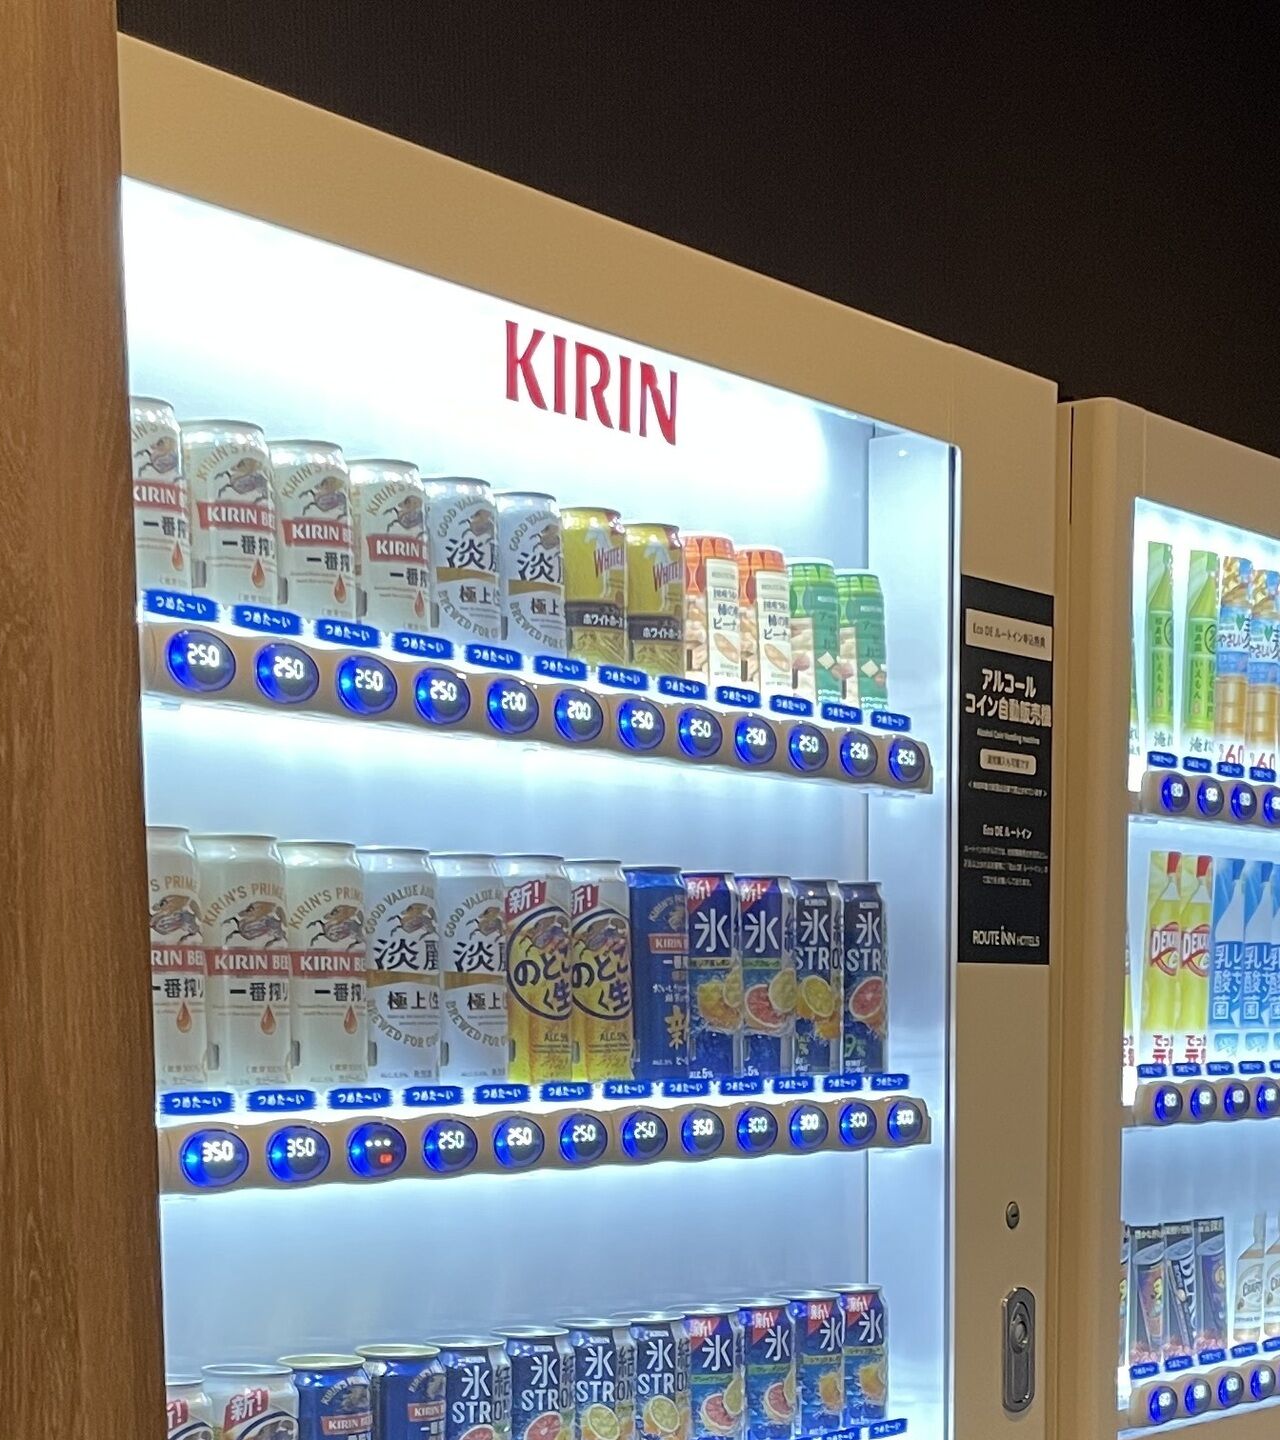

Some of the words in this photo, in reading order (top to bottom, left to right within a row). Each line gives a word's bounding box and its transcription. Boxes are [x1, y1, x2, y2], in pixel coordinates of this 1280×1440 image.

[506, 320, 677, 446] KIRIN
[207, 506, 257, 525] KIRIN
[292, 524, 339, 541] KIRIN
[376, 540, 420, 556] KIRIN
[187, 643, 220, 667] 250
[273, 656, 305, 680] 250
[355, 669, 383, 691] 250
[430, 679, 457, 701] 250
[981, 668, 1036, 698] アルコール
[502, 691, 526, 712] 200
[567, 700, 591, 720] 200
[965, 693, 1052, 727] コイン自動販売機
[631, 710, 654, 730] 250
[689, 718, 711, 737] 250
[746, 727, 766, 745] 250
[799, 735, 818, 752] 250
[850, 742, 868, 760] 250
[897, 749, 915, 766] 250
[384, 884, 418, 906] VALUE
[203, 885, 247, 928] KIRIN'S
[290, 889, 332, 930] KIRIN'S
[444, 906, 465, 938] GOOD
[972, 930, 1000, 946] ROUTE
[1017, 935, 1040, 947] HOTELS
[215, 954, 267, 970] KIRIN
[300, 955, 350, 971] KIRIN
[1214, 945, 1232, 1019] 乳酸菌
[1244, 945, 1261, 1019] 乳酸菌
[445, 1000, 481, 1040] BREWED
[404, 1034, 423, 1048] FOR
[634, 1120, 656, 1139] 250
[692, 1118, 713, 1136] 350
[748, 1116, 767, 1133] 300
[800, 1114, 819, 1131] 300
[438, 1131, 465, 1150] 250
[507, 1126, 532, 1146] 250
[573, 1124, 596, 1143] 250
[202, 1140, 234, 1163] 350
[287, 1137, 316, 1158] 350
[230, 1389, 262, 1422] 新!
[328, 1418, 358, 1430] KIRIN
